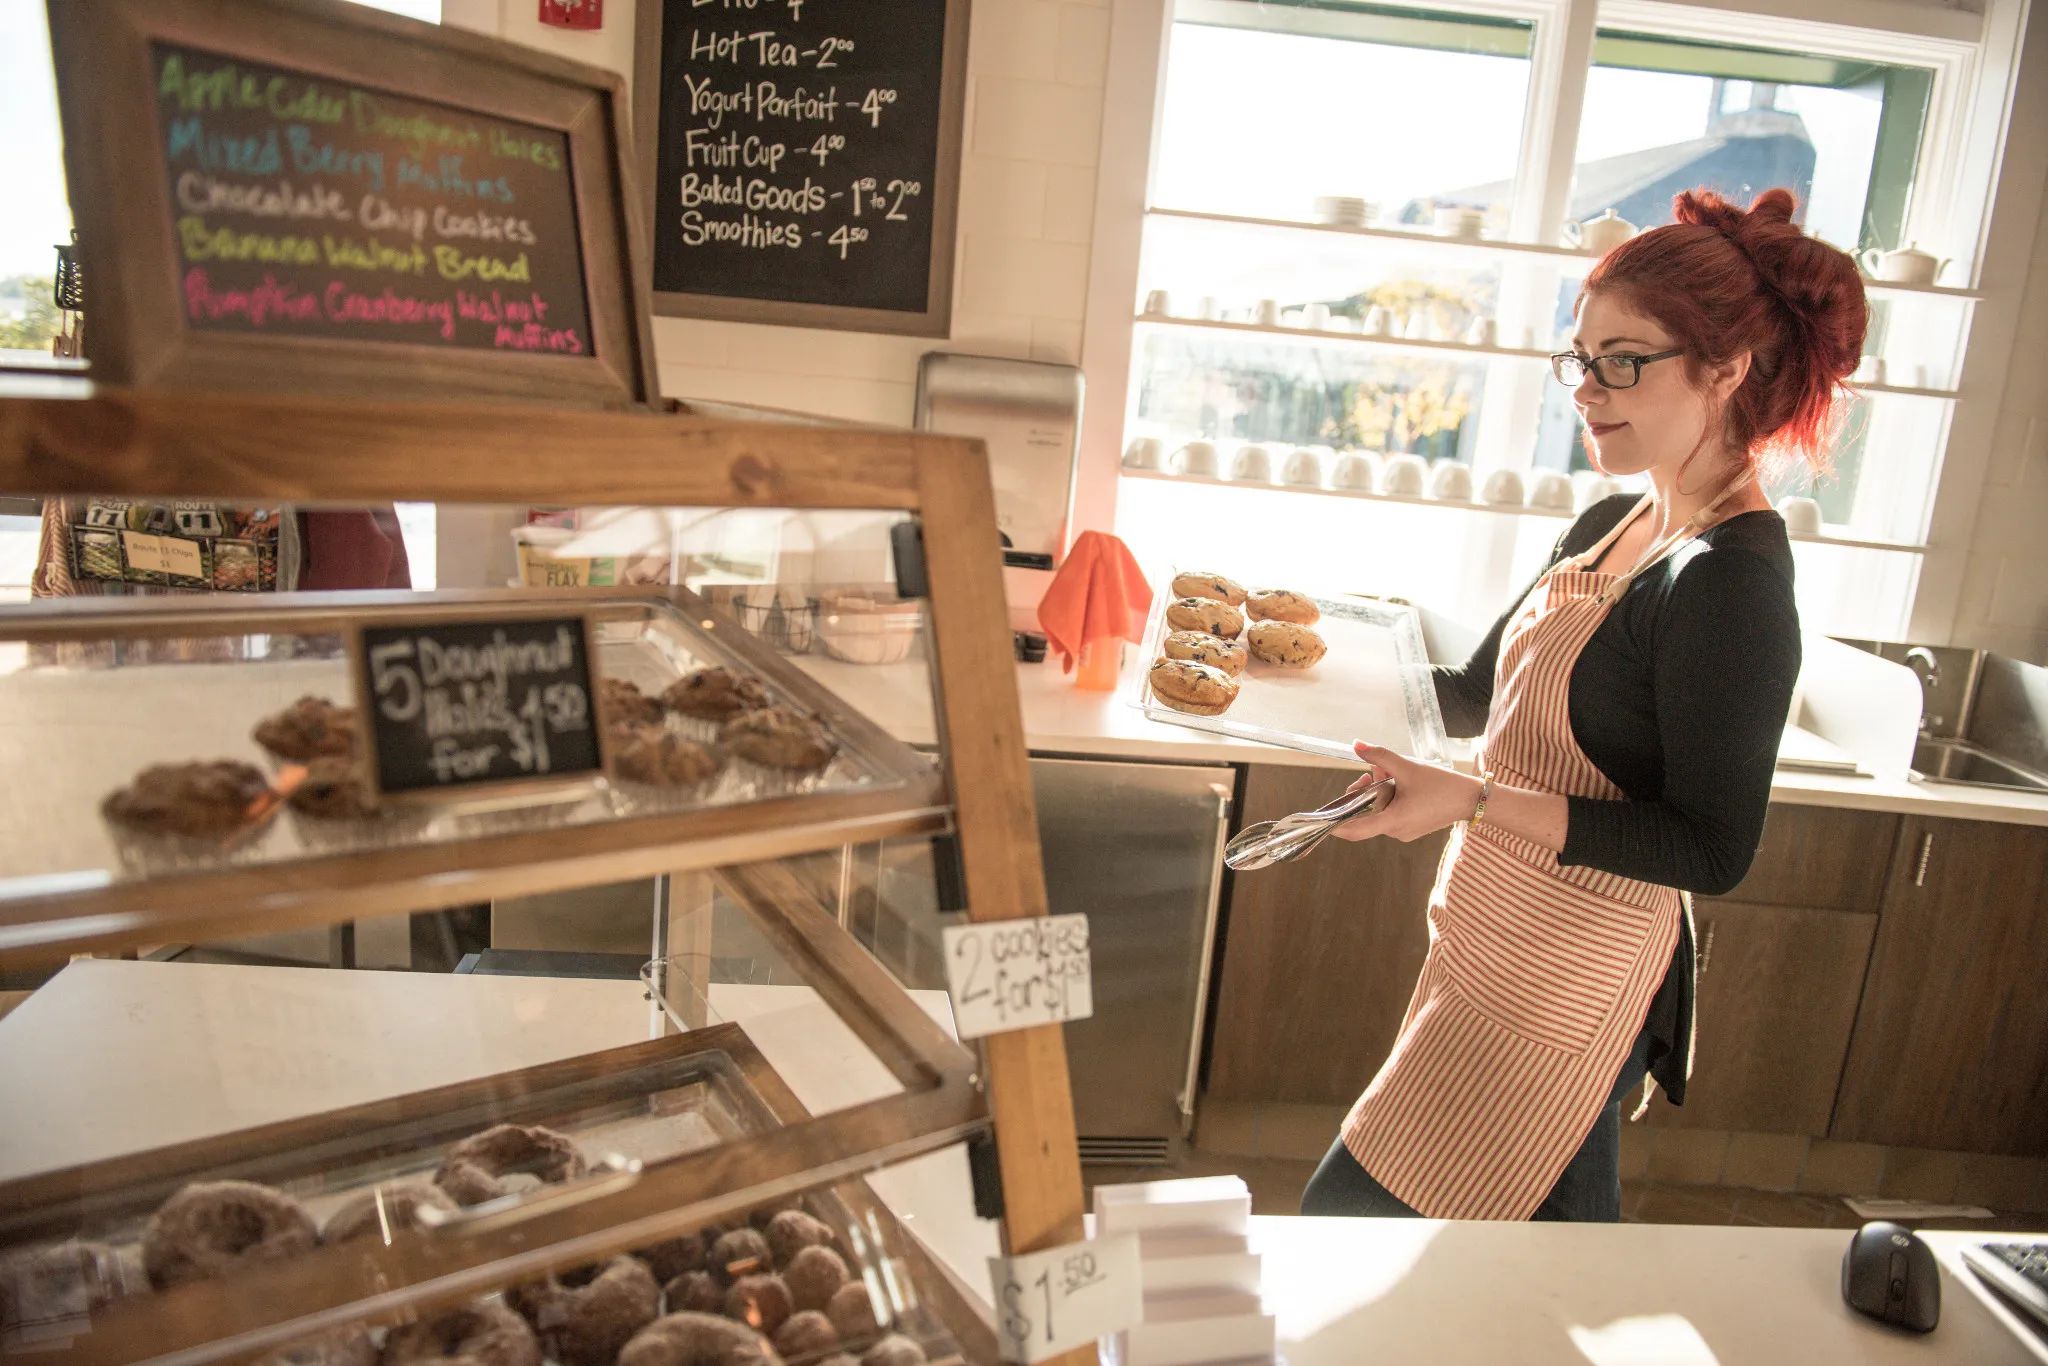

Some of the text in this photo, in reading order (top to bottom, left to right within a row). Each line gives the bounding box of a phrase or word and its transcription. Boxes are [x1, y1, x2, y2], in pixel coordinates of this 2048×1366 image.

[691, 30, 744, 63] Hot
[749, 32, 797, 66] Tea
[684, 74, 753, 129] Yogurt
[757, 81, 839, 121] Parfait
[168, 120, 280, 175] Mixed
[287, 126, 385, 191] Berry
[686, 129, 740, 168] Fruit
[743, 136, 786, 173] Cup
[177, 171, 537, 245] Chocolate Chip Cookies
[681, 173, 742, 208] Baked
[745, 177, 826, 215] Goods
[869, 192, 886, 209] to
[179, 217, 531, 282] Banana Walnut Bread
[681, 211, 802, 250] Smoothies
[324, 281, 455, 340] Cranberry
[457, 290, 549, 322] Walnut
[370, 638, 423, 721] 5
[956, 931, 992, 1005] 2
